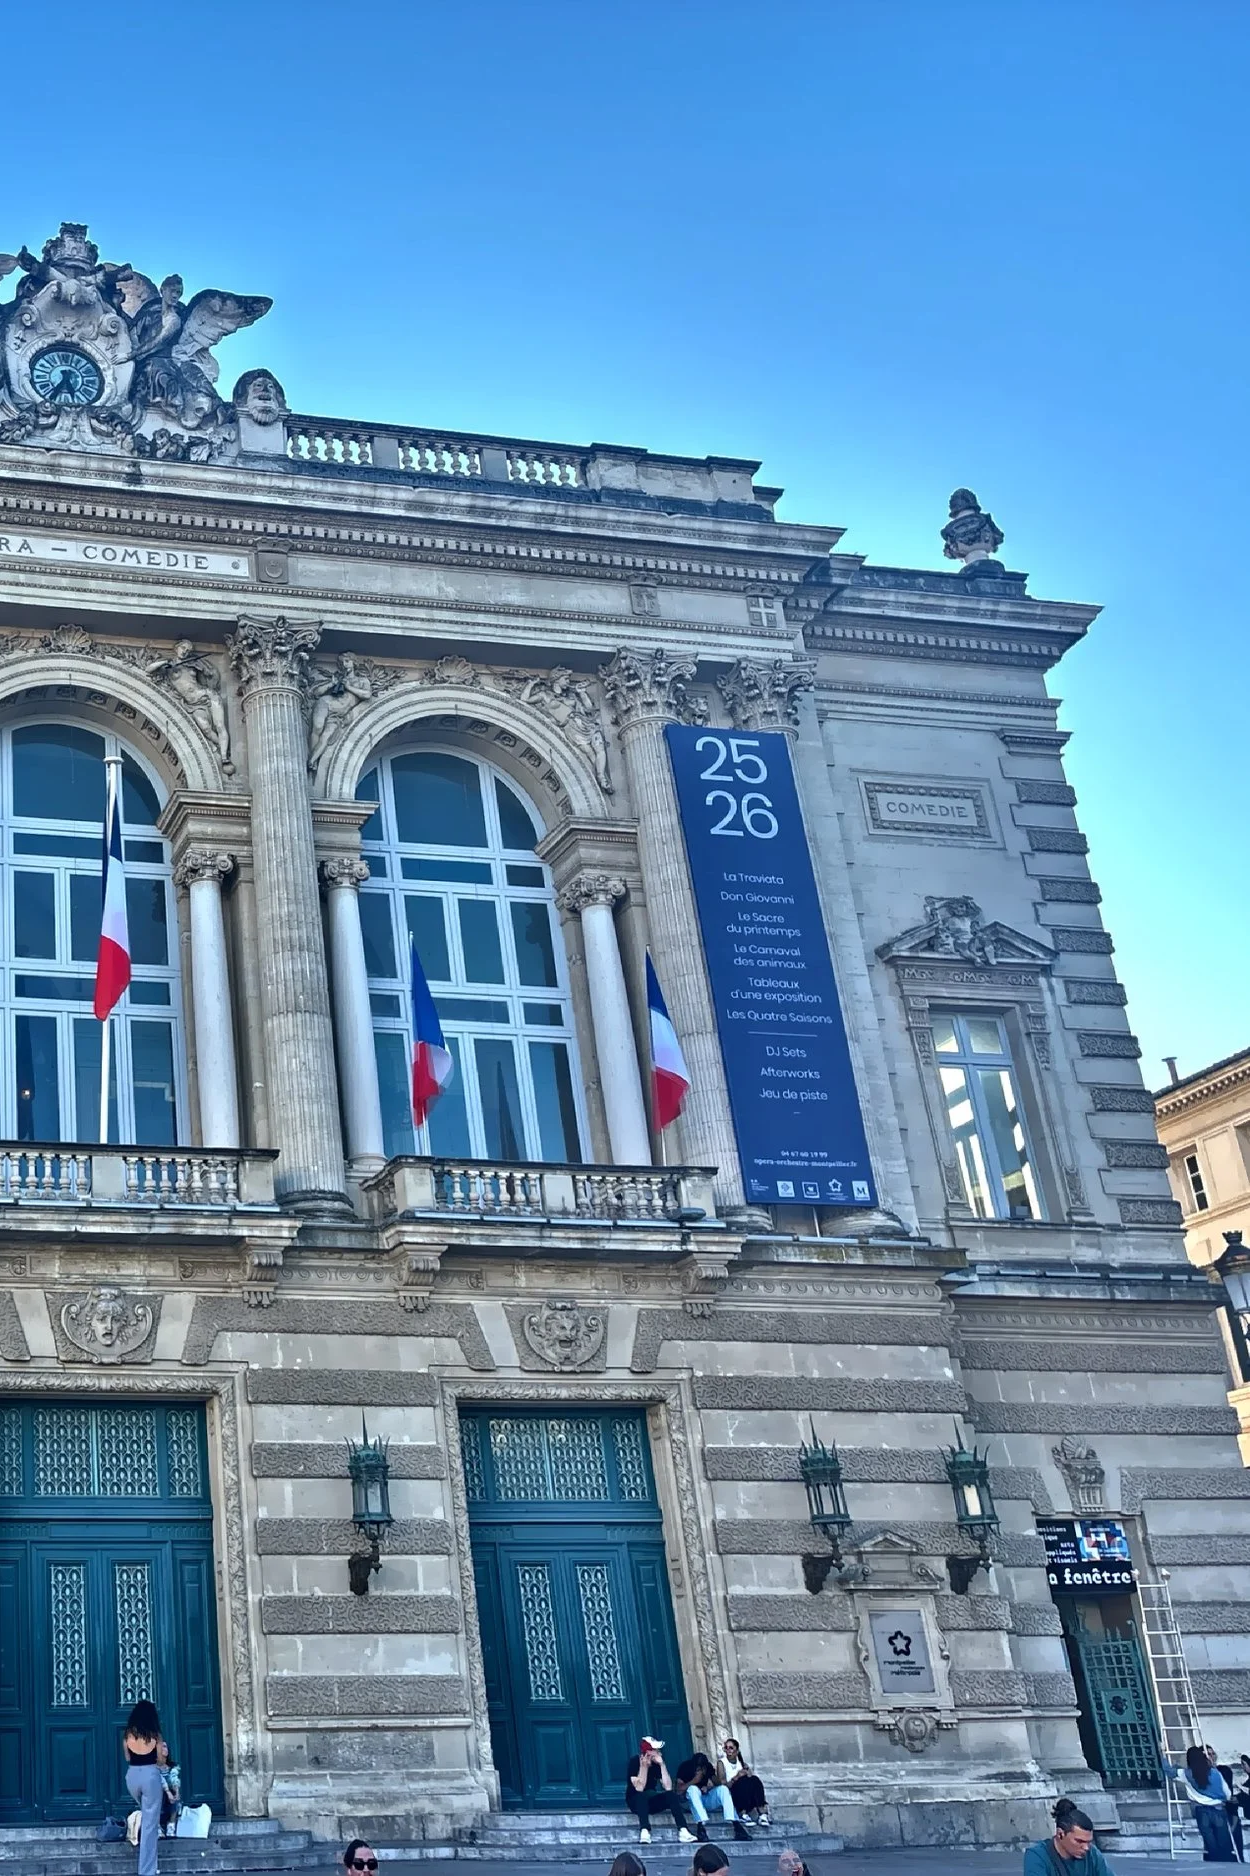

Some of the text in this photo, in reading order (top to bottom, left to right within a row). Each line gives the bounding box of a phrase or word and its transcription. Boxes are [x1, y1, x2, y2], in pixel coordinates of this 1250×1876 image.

[83, 544, 210, 570] COMEDIE
[695, 736, 769, 785] 25
[705, 789, 779, 840] 26
[887, 801, 969, 818] COMEDIE
[723, 872, 784, 885] La Traviata
[720, 891, 795, 904] Don Giovanni
[737, 912, 785, 923] Le Sacre
[726, 923, 802, 938] du printemps
[734, 944, 801, 957] Le Carnaval
[733, 956, 807, 969] des animaux
[748, 977, 800, 989] Tableaux
[730, 989, 822, 1004] d'une exposition
[726, 1009, 833, 1024] Les Quatre Saisons
[765, 1046, 807, 1058] DJ Sets
[760, 1067, 821, 1080] Afterworks
[759, 1088, 828, 1102] Jeu de piste
[1049, 1567, 1132, 1585] a fenêtre
